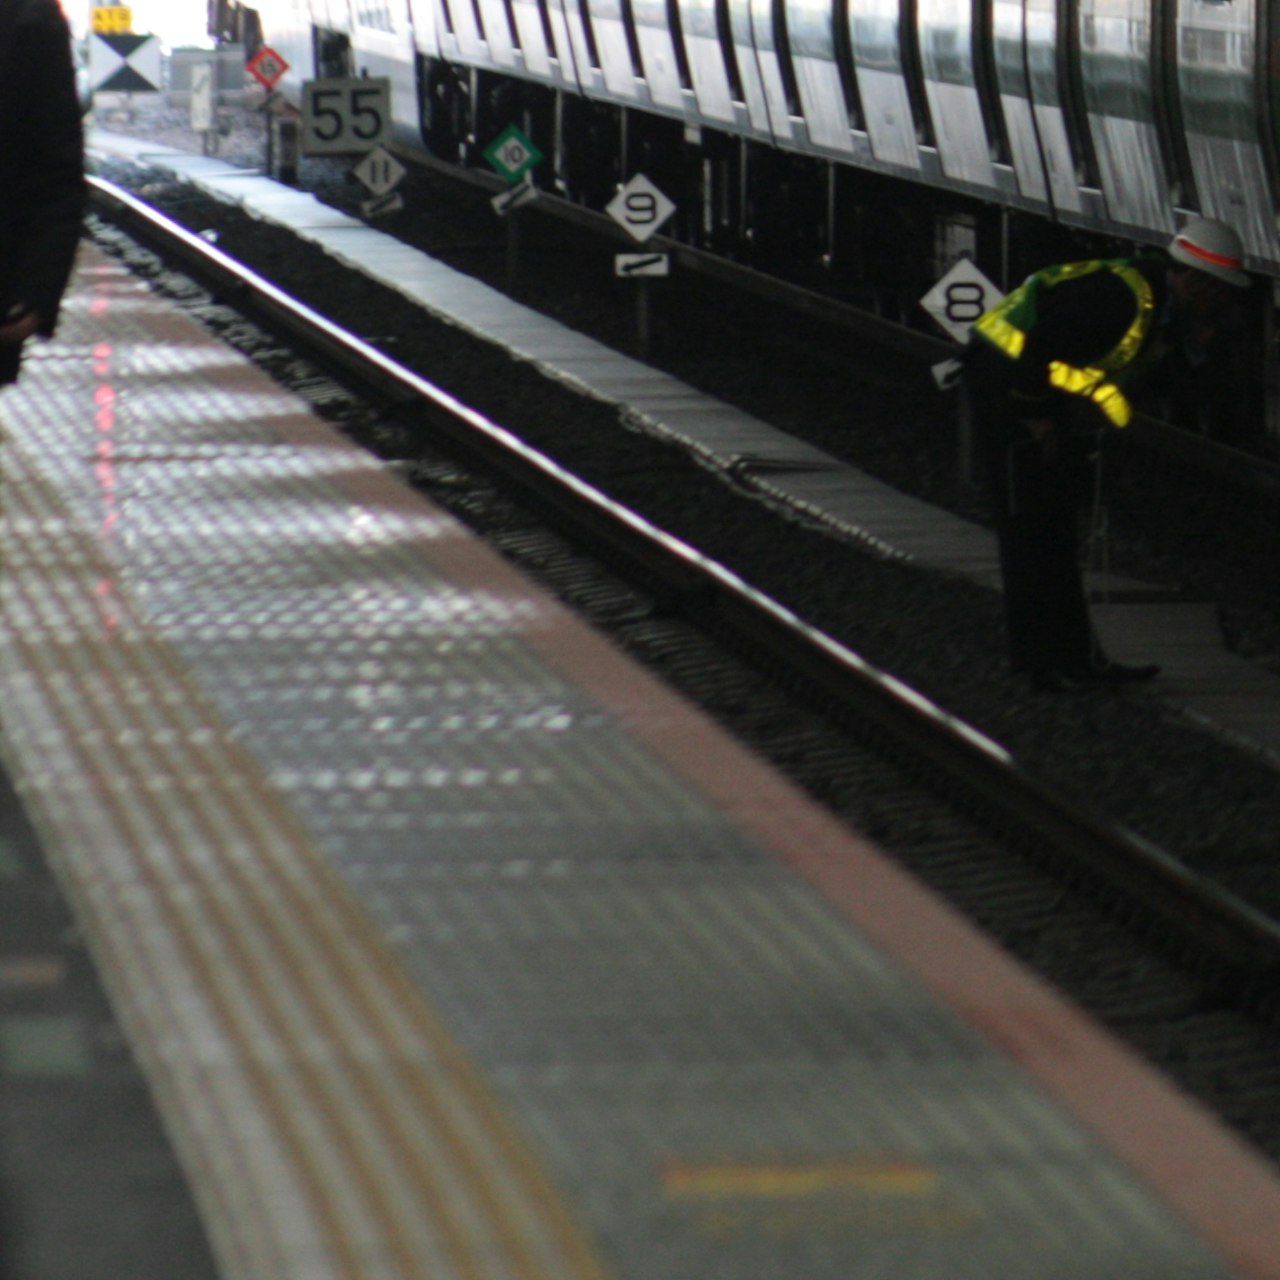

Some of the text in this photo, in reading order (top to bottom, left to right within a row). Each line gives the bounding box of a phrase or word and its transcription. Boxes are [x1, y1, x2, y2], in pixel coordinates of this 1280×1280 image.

[311, 90, 383, 142] 55
[504, 145, 524, 164] 10
[370, 160, 389, 184] 11
[624, 192, 658, 225] 9
[944, 283, 984, 322] 8
